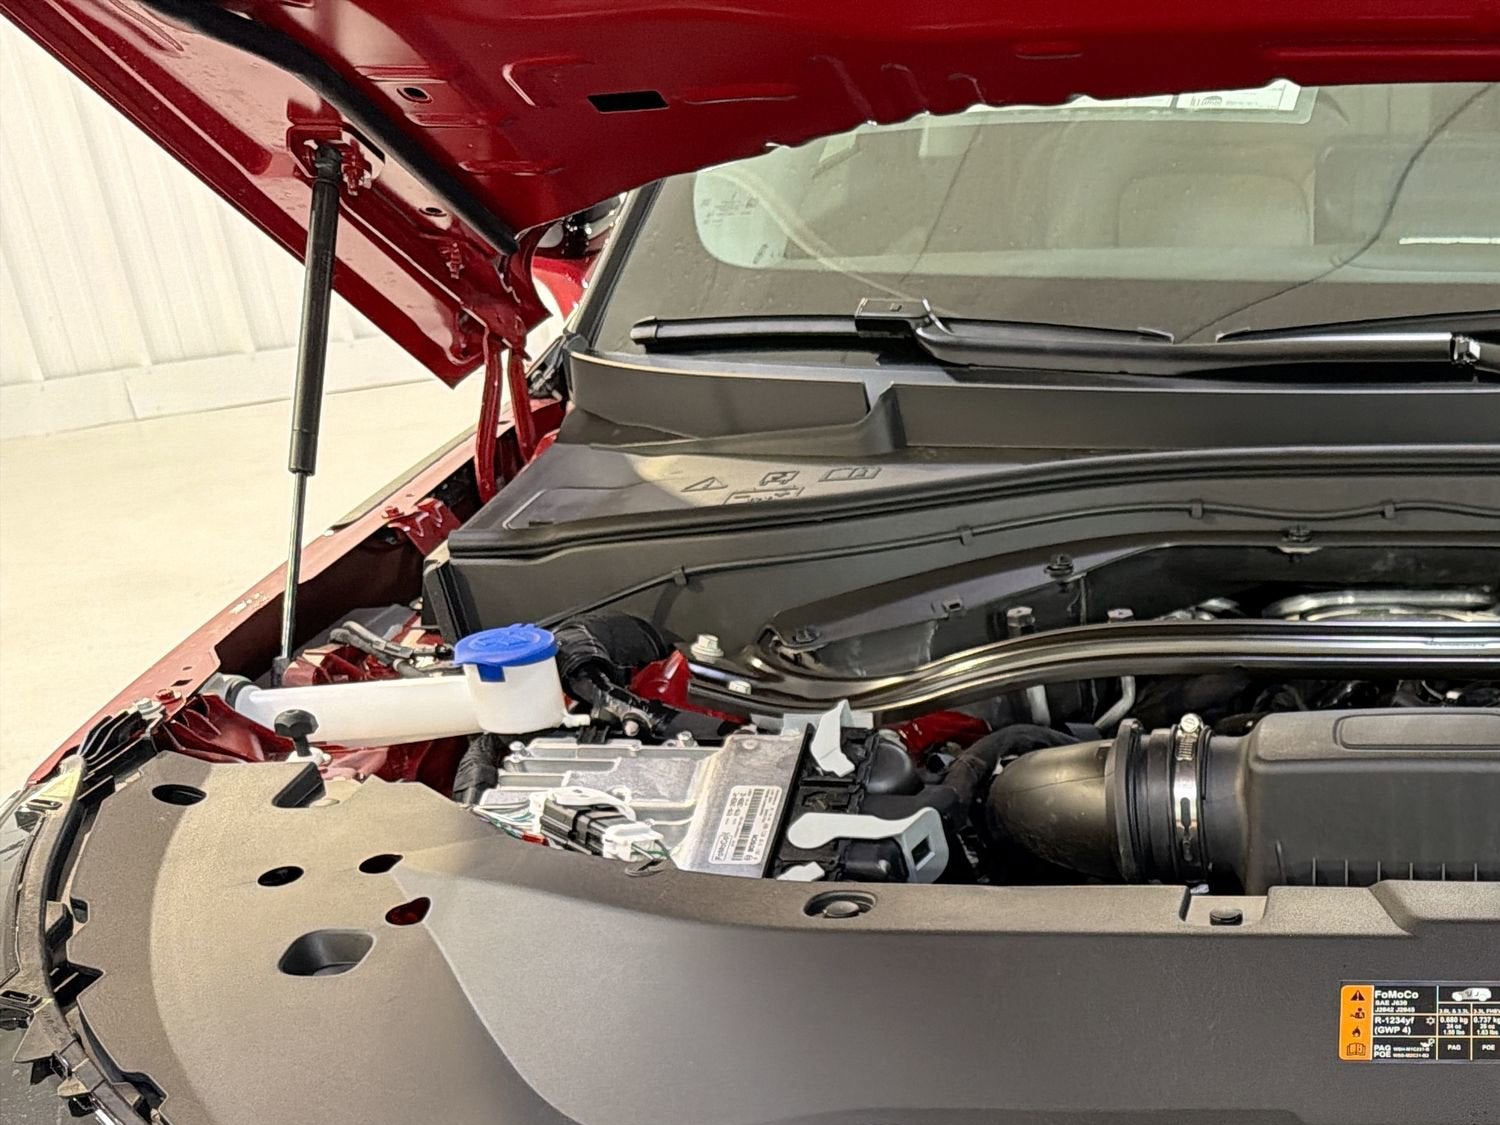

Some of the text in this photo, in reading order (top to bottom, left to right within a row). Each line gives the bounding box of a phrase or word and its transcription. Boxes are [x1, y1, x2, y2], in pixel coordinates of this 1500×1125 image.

[1374, 990, 1419, 999] FoMoCo
[1375, 1017, 1414, 1025] R-1234yf
[1459, 1017, 1469, 1025] kg
[1374, 1026, 1412, 1035] (GWP 4)
